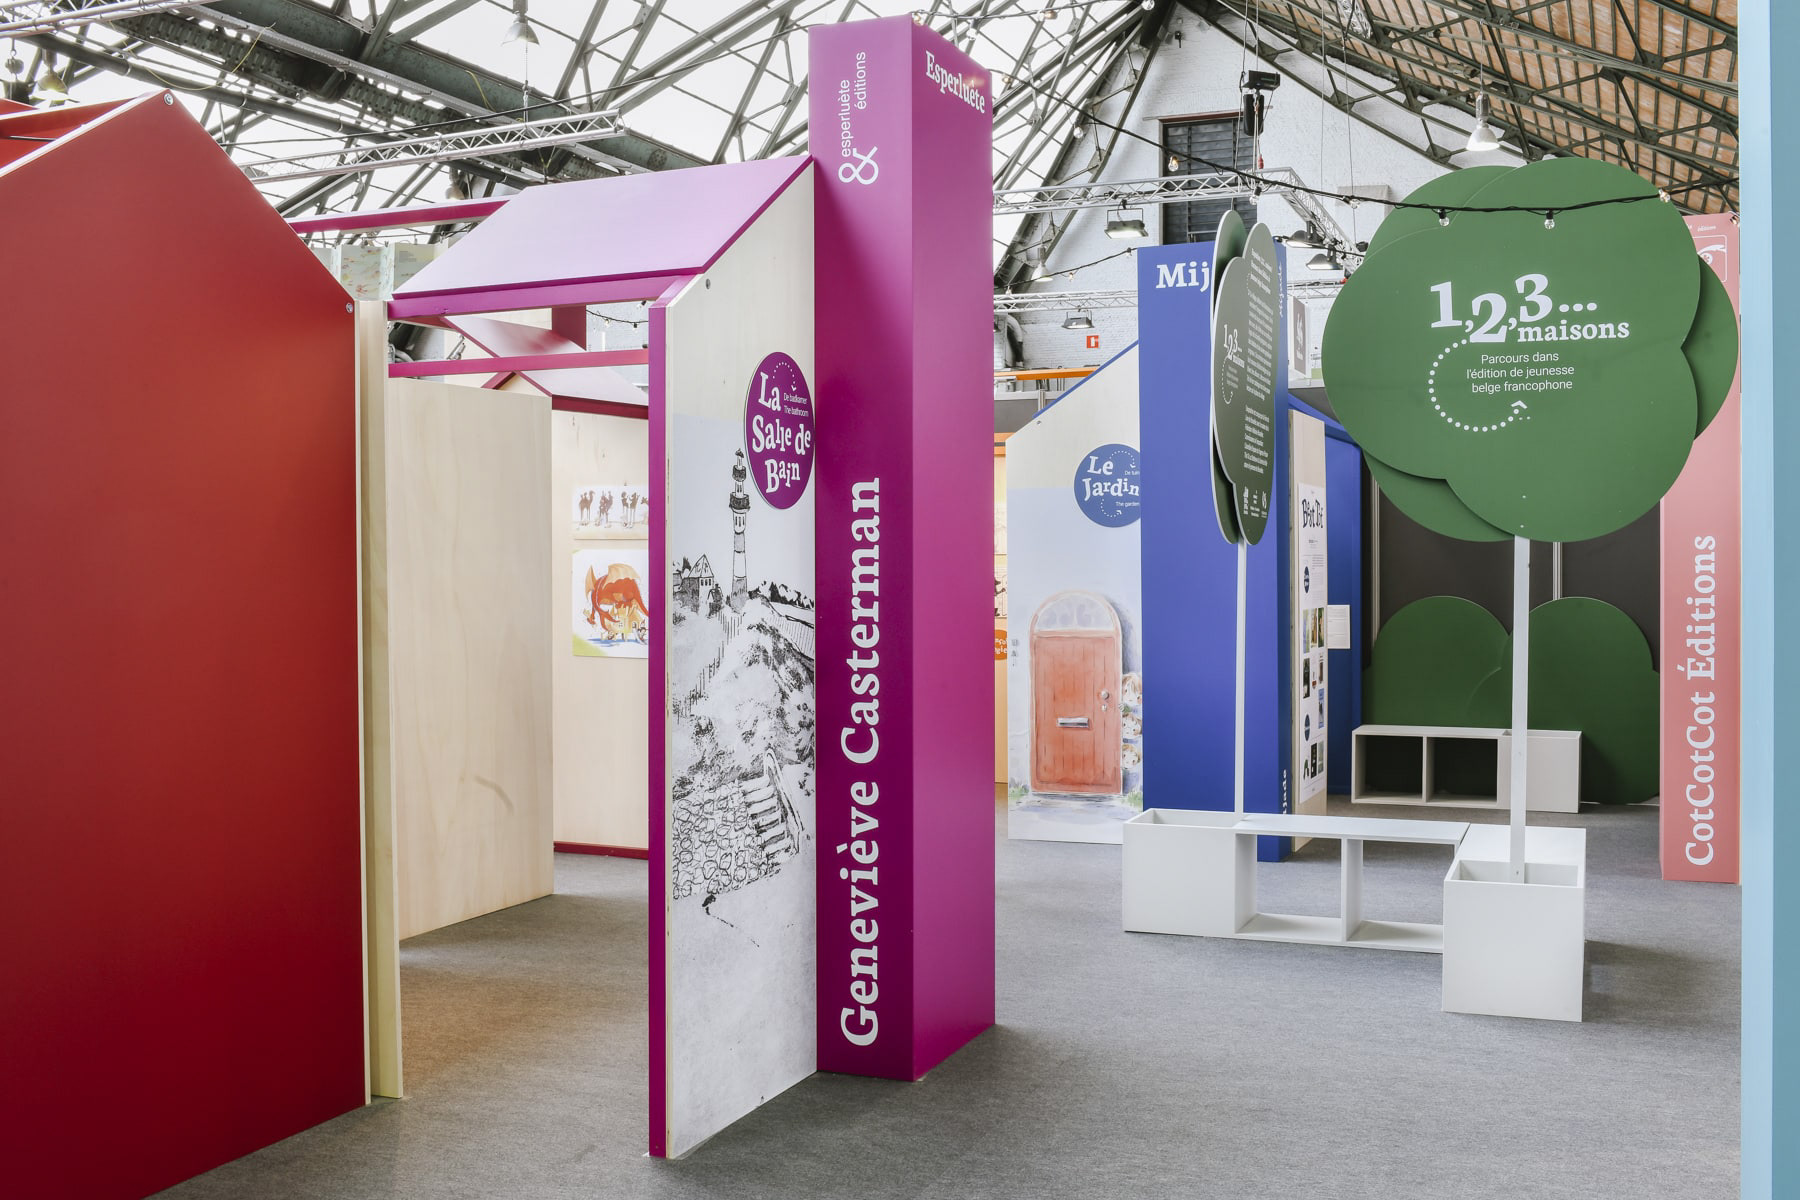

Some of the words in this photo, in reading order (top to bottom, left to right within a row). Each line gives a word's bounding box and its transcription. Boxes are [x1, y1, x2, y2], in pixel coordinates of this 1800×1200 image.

[854, 51, 867, 110] éditions
[925, 50, 986, 114] Esperluète
[838, 79, 854, 157] esperluète
[1155, 261, 1210, 293] Mij
[1517, 319, 1630, 342] maisons
[1466, 368, 1507, 379] l'édition
[1510, 366, 1523, 377] de
[1525, 366, 1575, 378] jeunesse
[1481, 353, 1530, 364] Parcours
[1532, 352, 1559, 362] dans
[758, 371, 782, 412] La
[1472, 382, 1501, 395] belge
[1503, 380, 1573, 392] francophone
[752, 414, 792, 453] Salle
[795, 423, 812, 455] de
[765, 458, 801, 493] Bain
[1087, 455, 1114, 475] Le
[1082, 477, 1140, 501] Jardin
[840, 477, 880, 764] Casterman
[1676, 535, 1715, 680] Éditions
[1685, 691, 1715, 866] CotCotCot
[836, 781, 879, 1046] Geneviève
